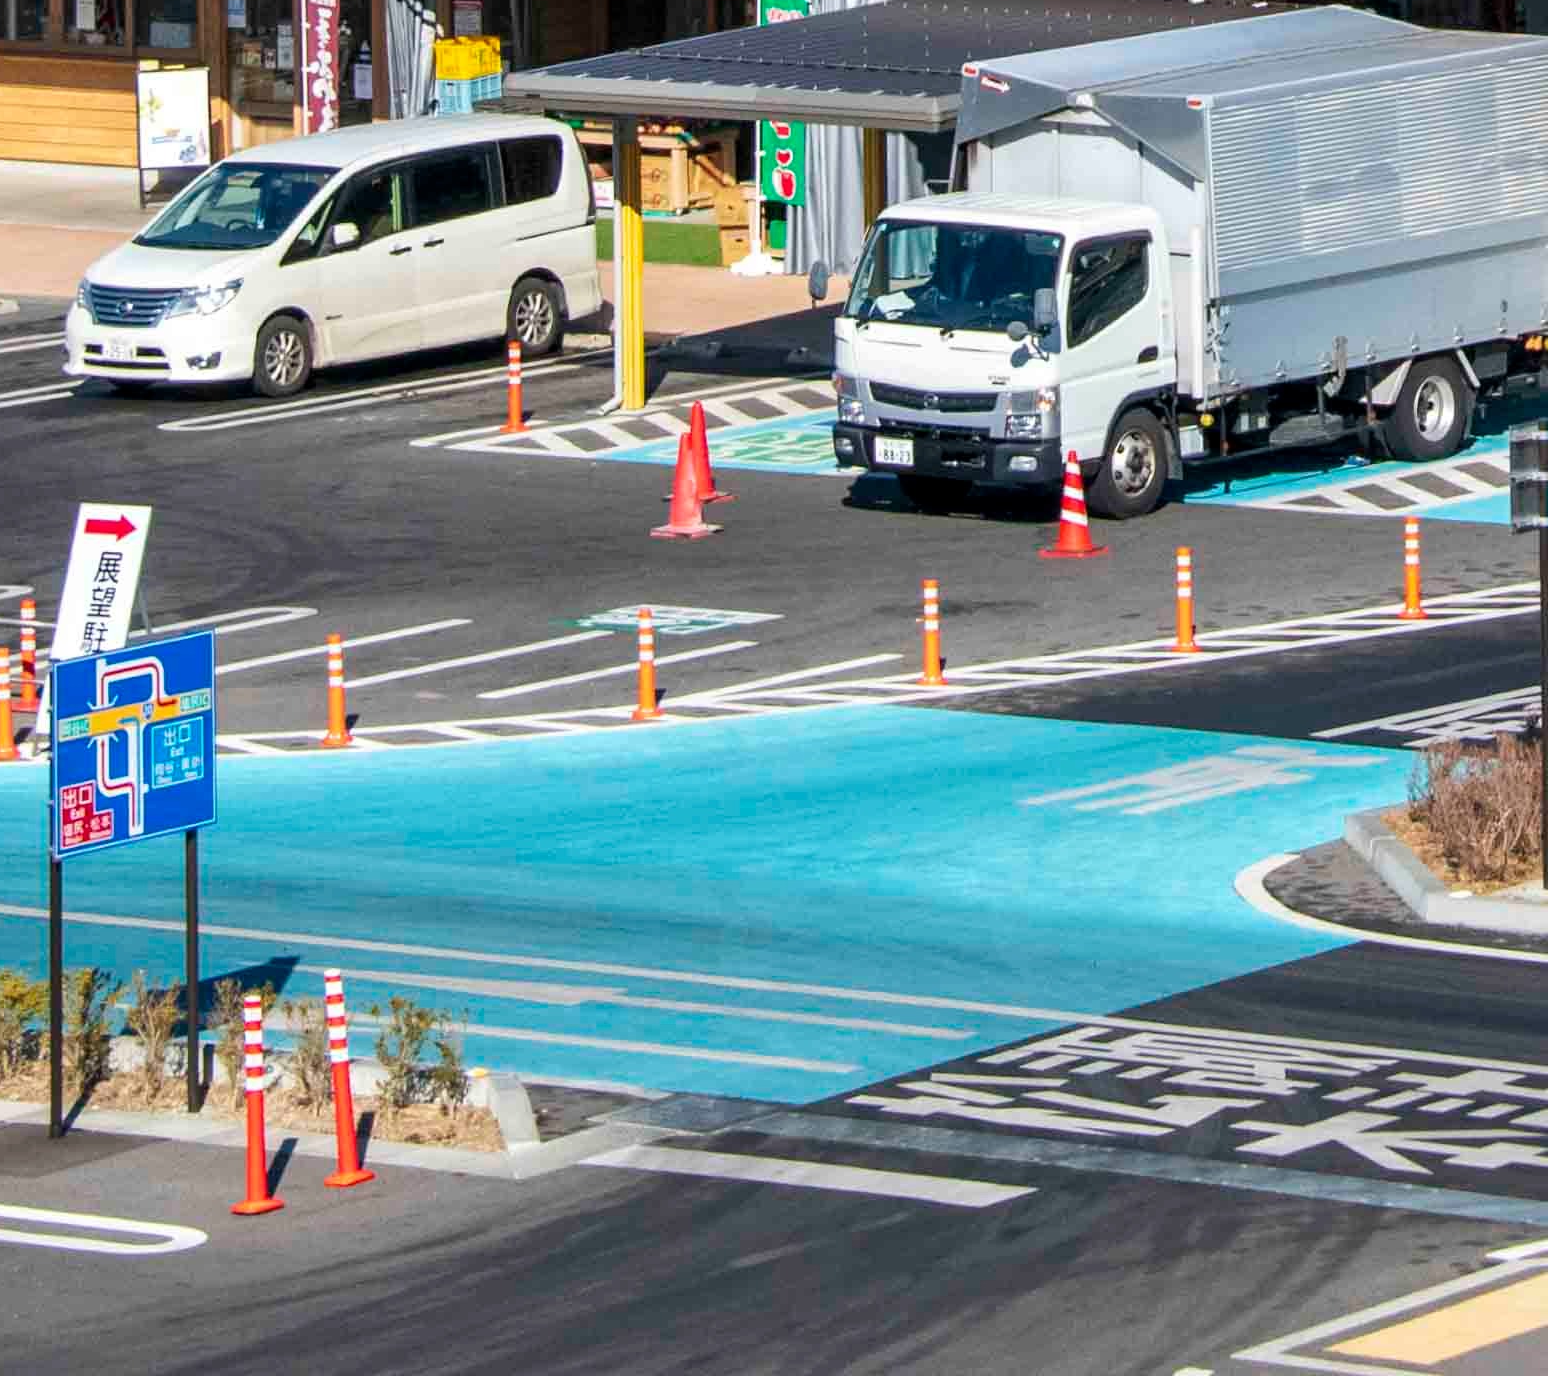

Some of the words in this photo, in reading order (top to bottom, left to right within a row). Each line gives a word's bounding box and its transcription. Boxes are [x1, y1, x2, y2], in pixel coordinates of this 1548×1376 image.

[79, 551, 124, 654] 展望駐
[163, 722, 192, 747] 出口
[62, 785, 94, 809] 出口
